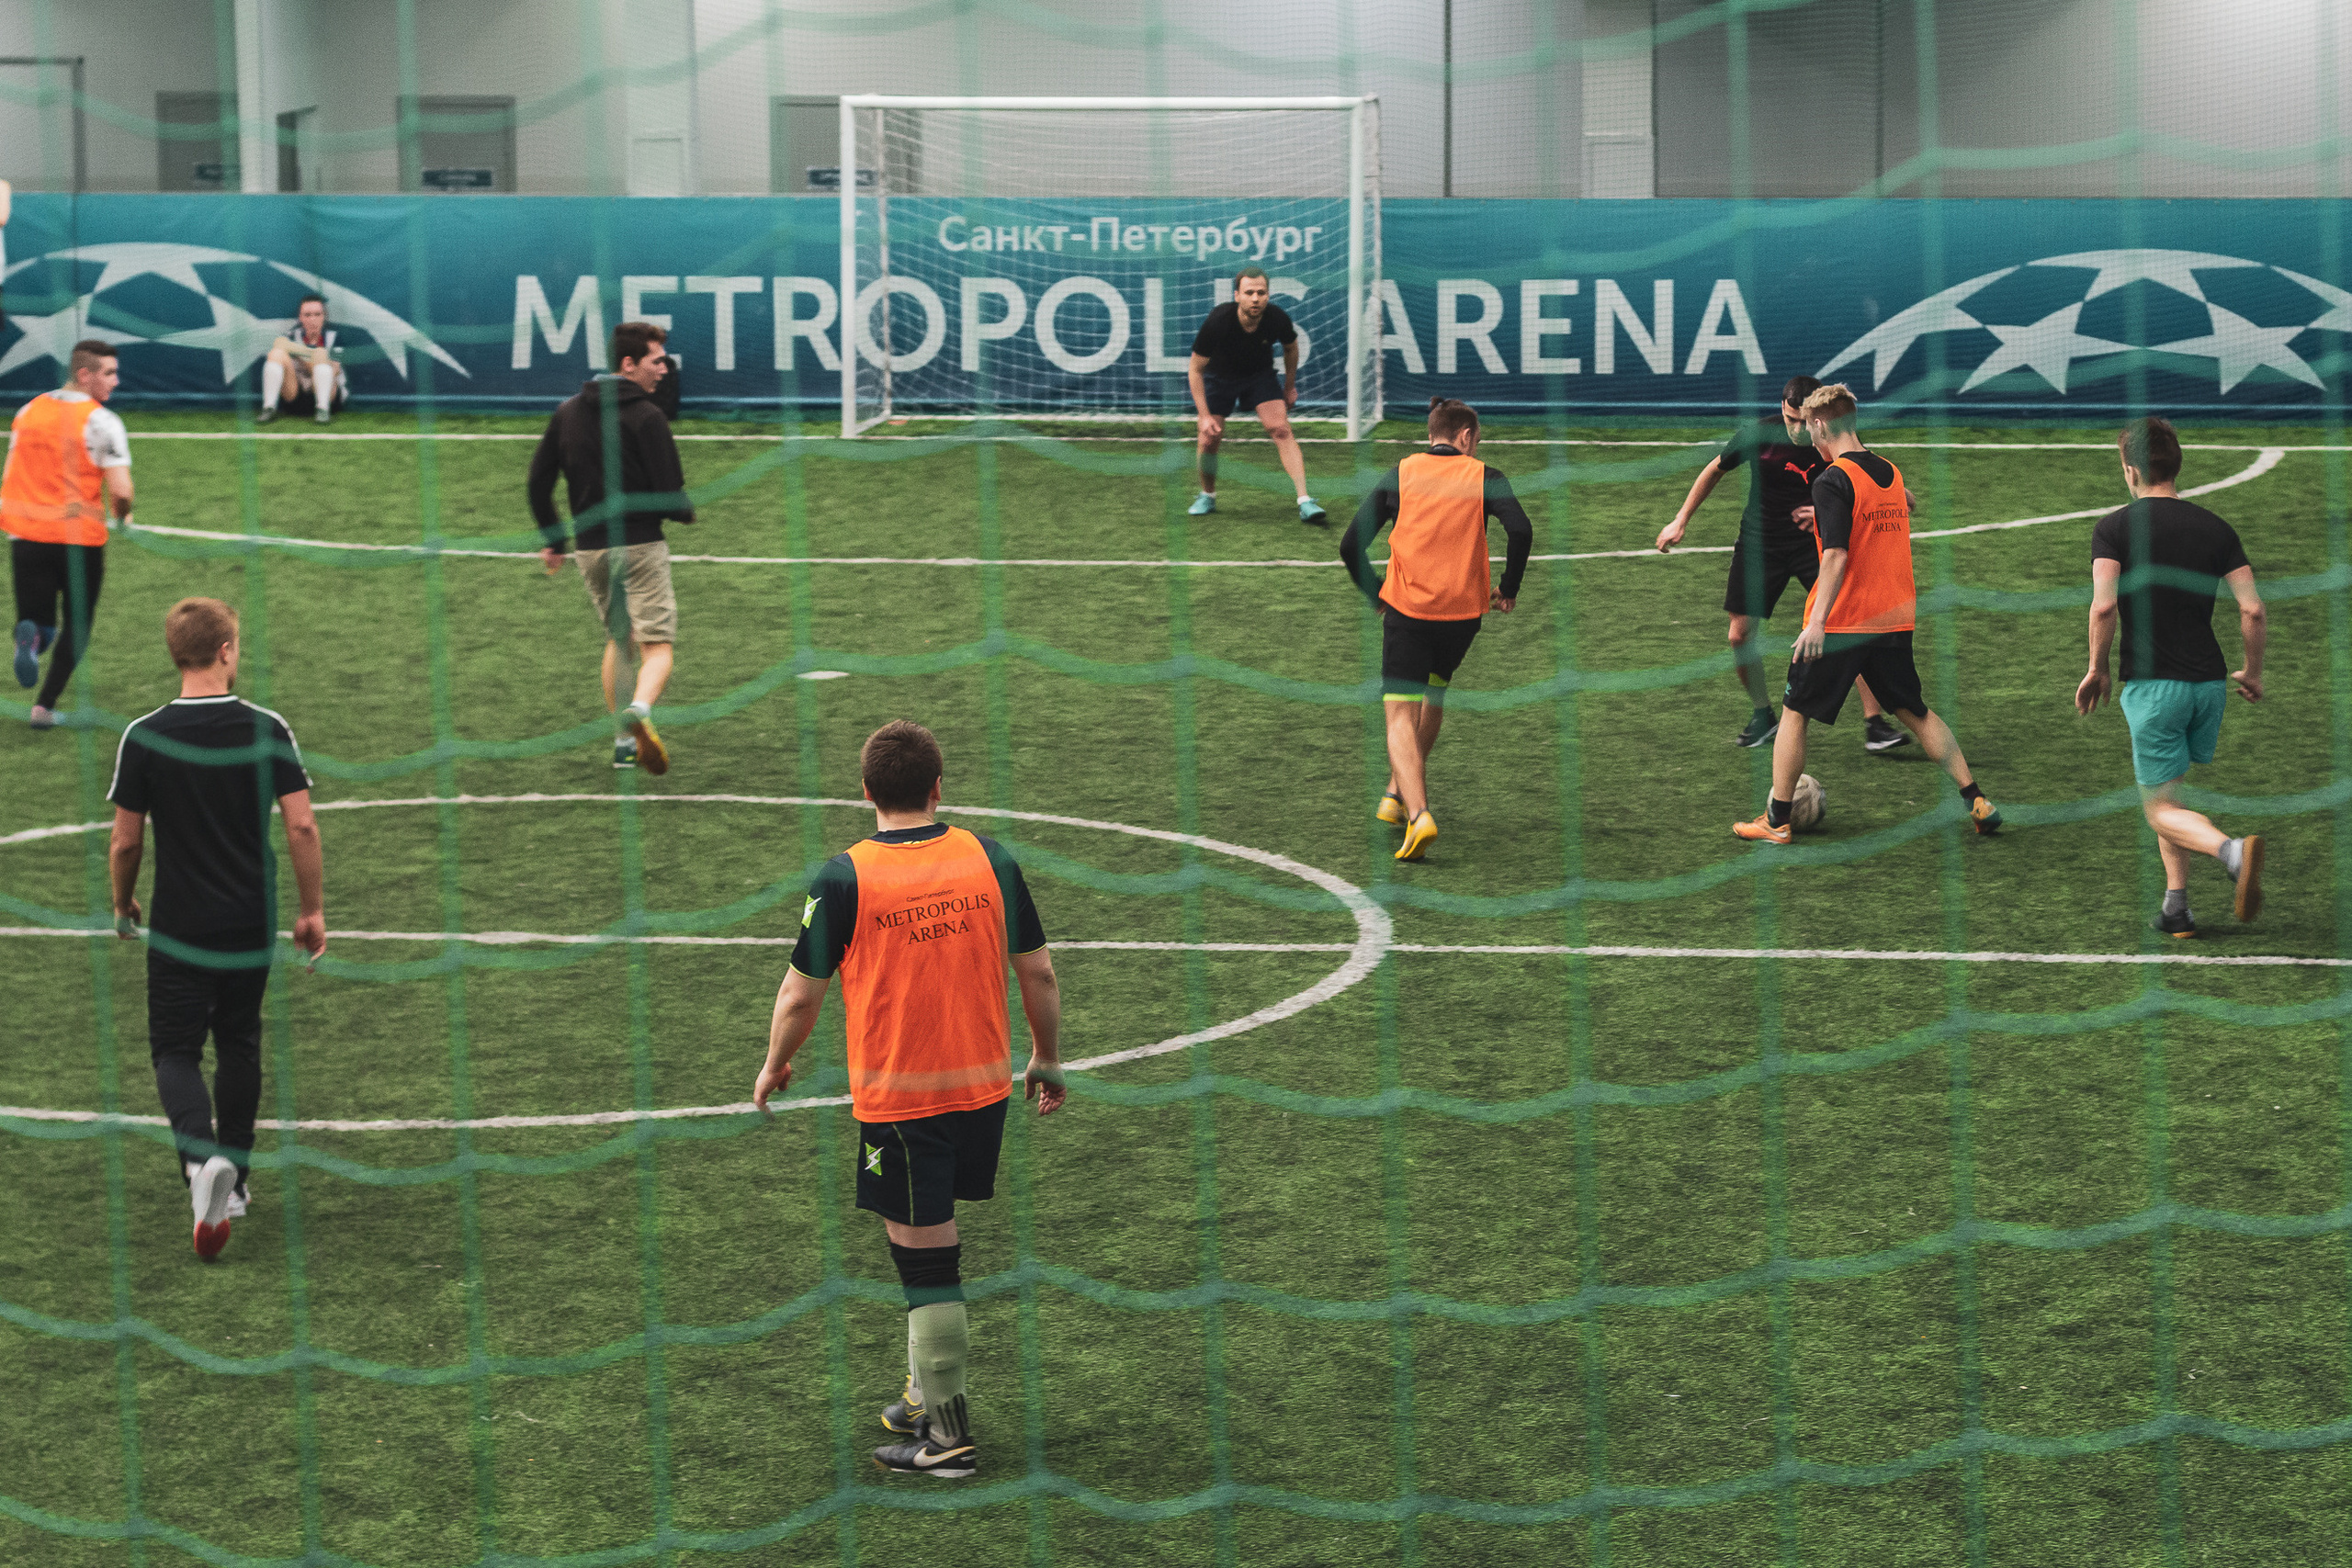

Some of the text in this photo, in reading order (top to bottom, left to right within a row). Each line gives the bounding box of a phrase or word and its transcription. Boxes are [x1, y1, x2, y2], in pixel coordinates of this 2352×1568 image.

[938, 216, 1323, 261] Санкт-Петербург
[511, 275, 1769, 374] METROPOLS ARENA
[1873, 522, 1901, 533] ARENA
[875, 893, 990, 931] METROPOLIS
[908, 919, 969, 944] ARENA
